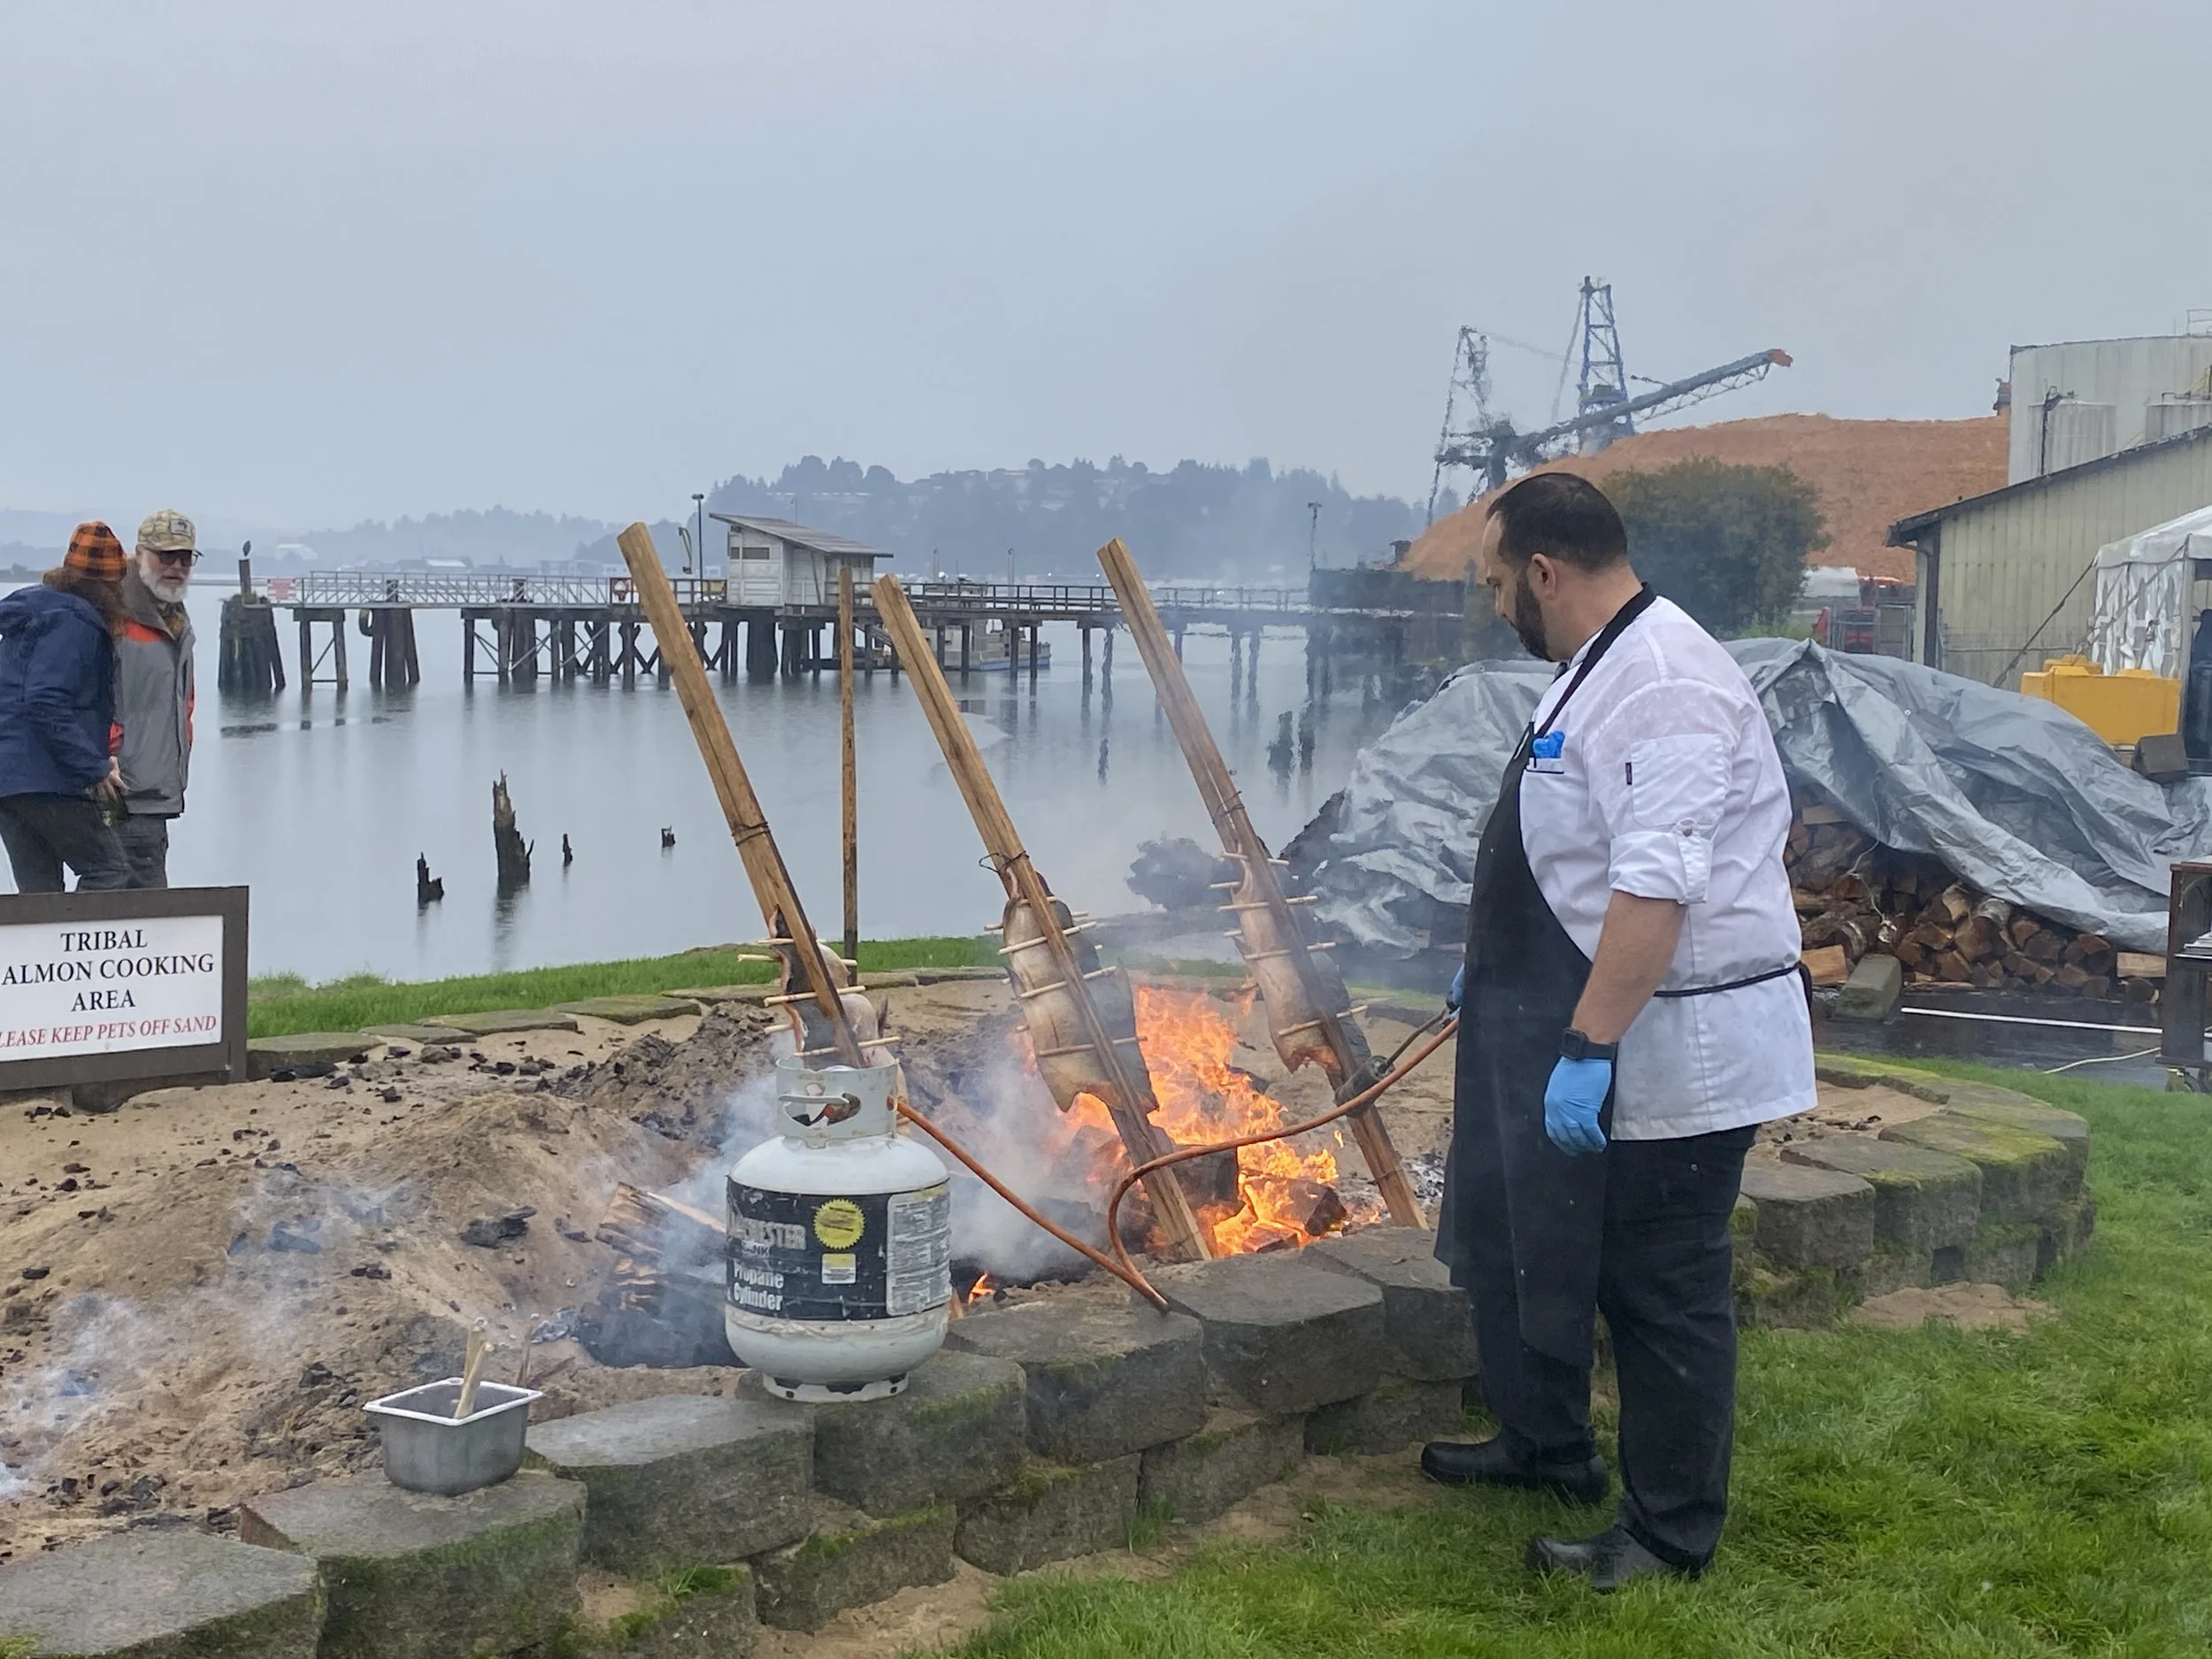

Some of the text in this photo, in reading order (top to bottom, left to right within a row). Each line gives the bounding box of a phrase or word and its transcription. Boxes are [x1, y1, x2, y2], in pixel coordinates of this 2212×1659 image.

[60, 929, 148, 952] TRIBAL
[1, 954, 214, 986] ALMON COOKING
[71, 989, 136, 1012] AREA
[51, 1025, 94, 1044] KEEP
[96, 1021, 136, 1041] PETS
[140, 1018, 172, 1037] OFF
[173, 1015, 217, 1034] SAND
[733, 1281, 784, 1311] Cylinder
